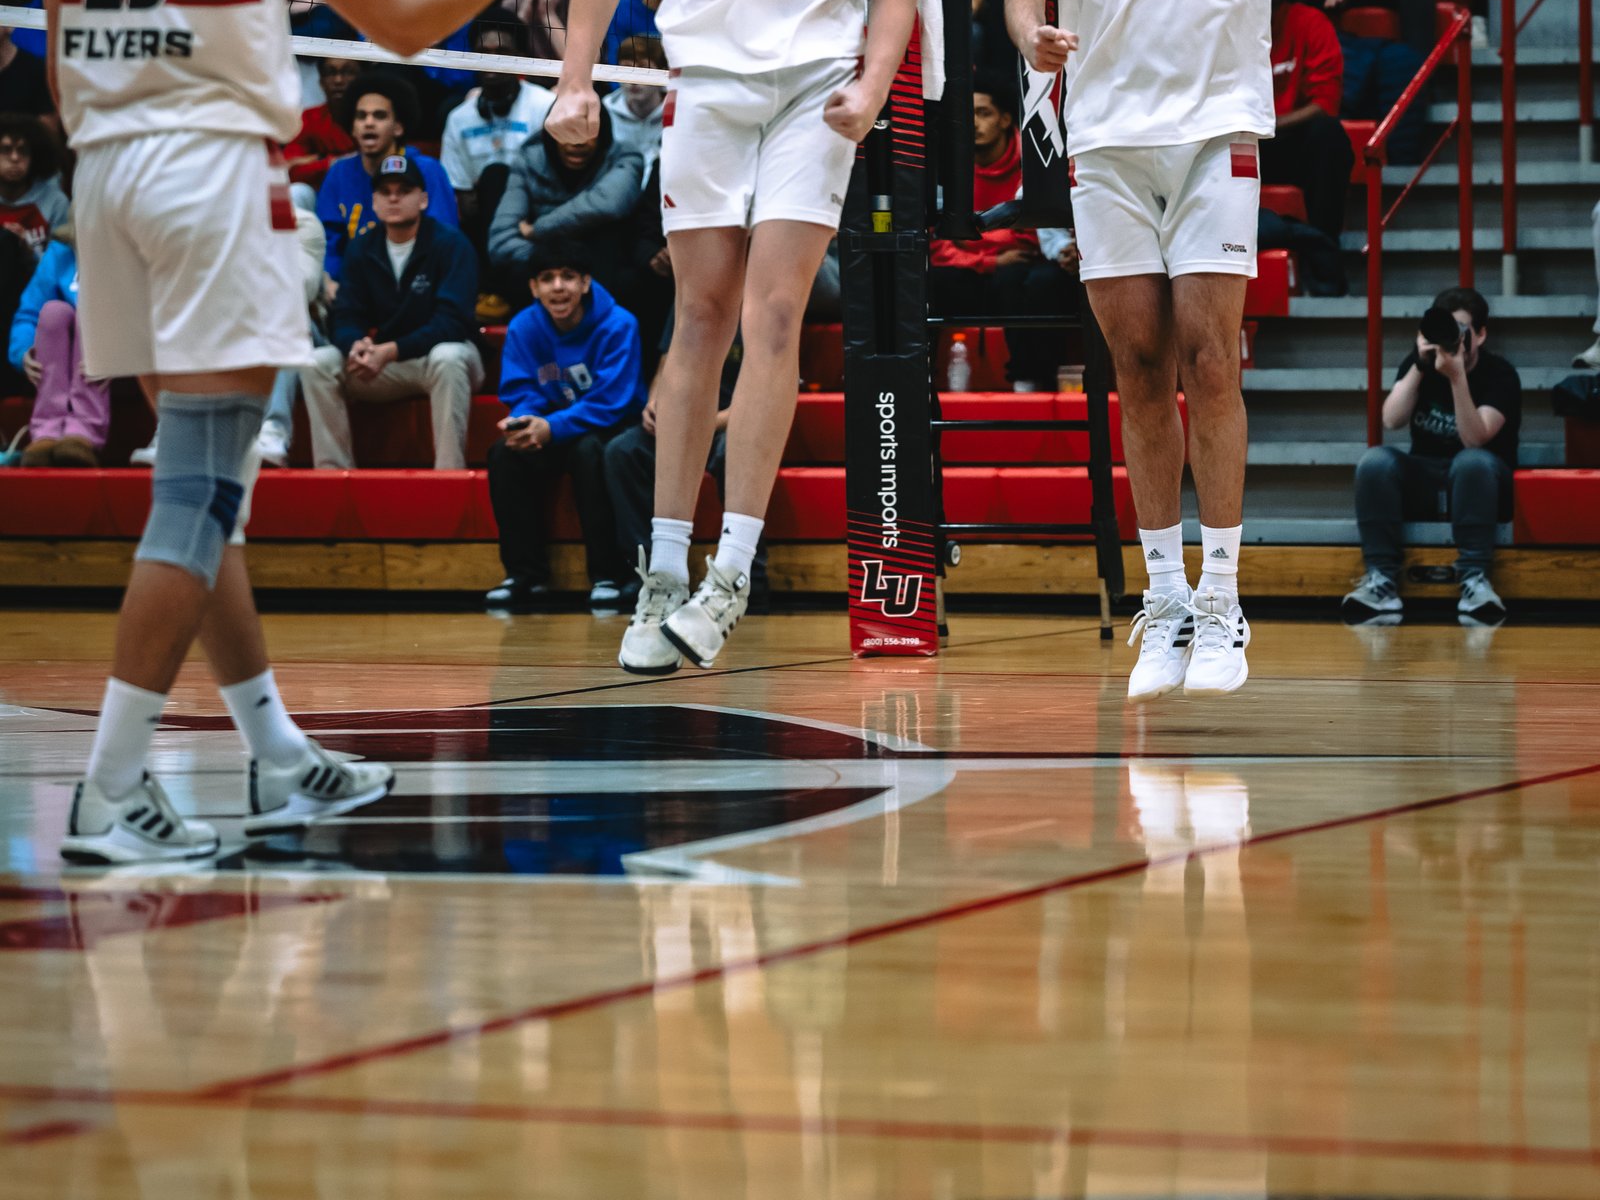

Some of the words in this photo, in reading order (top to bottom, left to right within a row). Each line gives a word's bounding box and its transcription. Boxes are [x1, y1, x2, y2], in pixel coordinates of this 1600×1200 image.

[63, 29, 193, 59] FLYERS
[875, 392, 898, 460] sports
[877, 464, 900, 548] imports
[861, 560, 923, 617] LU
